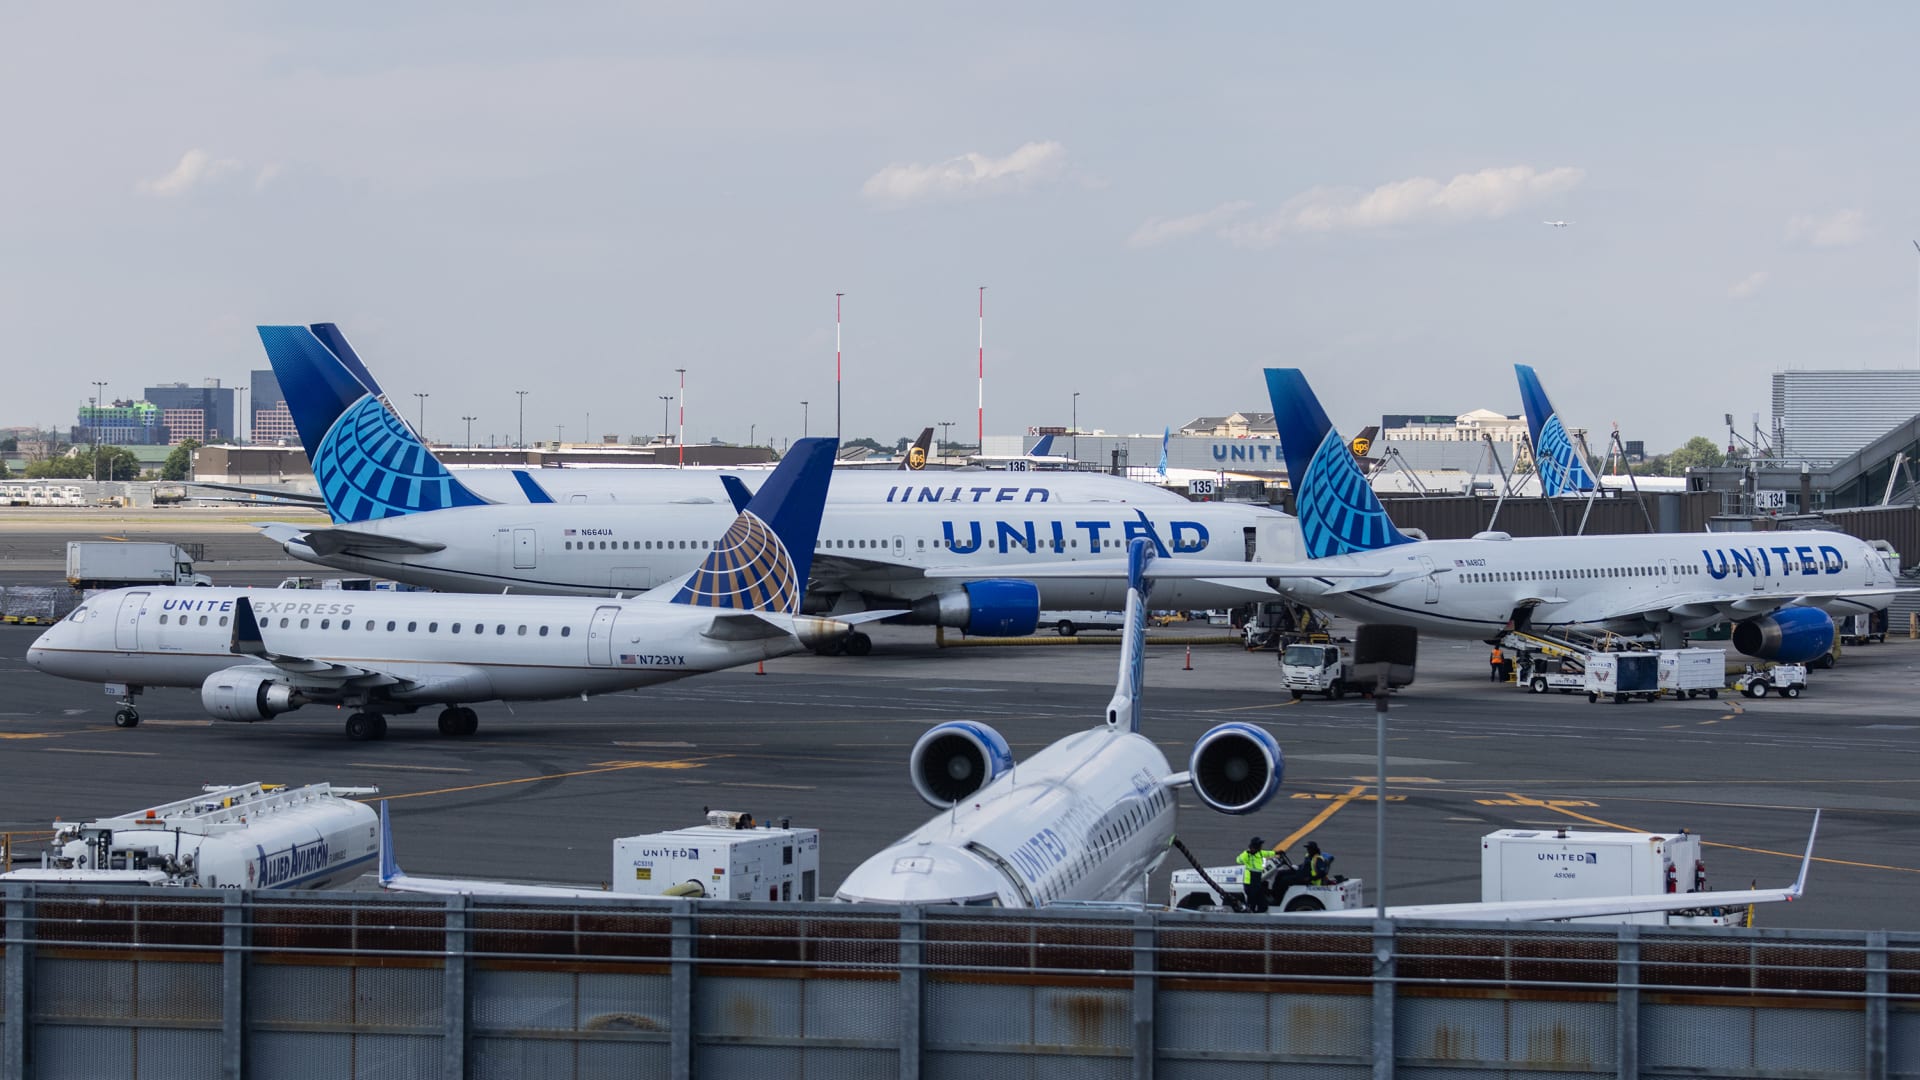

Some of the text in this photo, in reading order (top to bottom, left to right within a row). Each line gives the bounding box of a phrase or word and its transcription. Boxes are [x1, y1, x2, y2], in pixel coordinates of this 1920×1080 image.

[1213, 445, 1285, 462] UNITE
[1009, 462, 1026, 472] 136
[1193, 481, 1212, 493] 135
[1769, 493, 1784, 507] 134
[1701, 545, 1844, 580] UNITED
[162, 599, 233, 612] UNITE
[253, 601, 355, 616] EXPRESS
[639, 654, 686, 665] N723YX
[642, 848, 688, 858] UNITED
[1009, 827, 1068, 884] UNITED
[1537, 853, 1585, 862] UNITED
[256, 844, 290, 889] ALLIED
[290, 842, 328, 877] AVIATION
